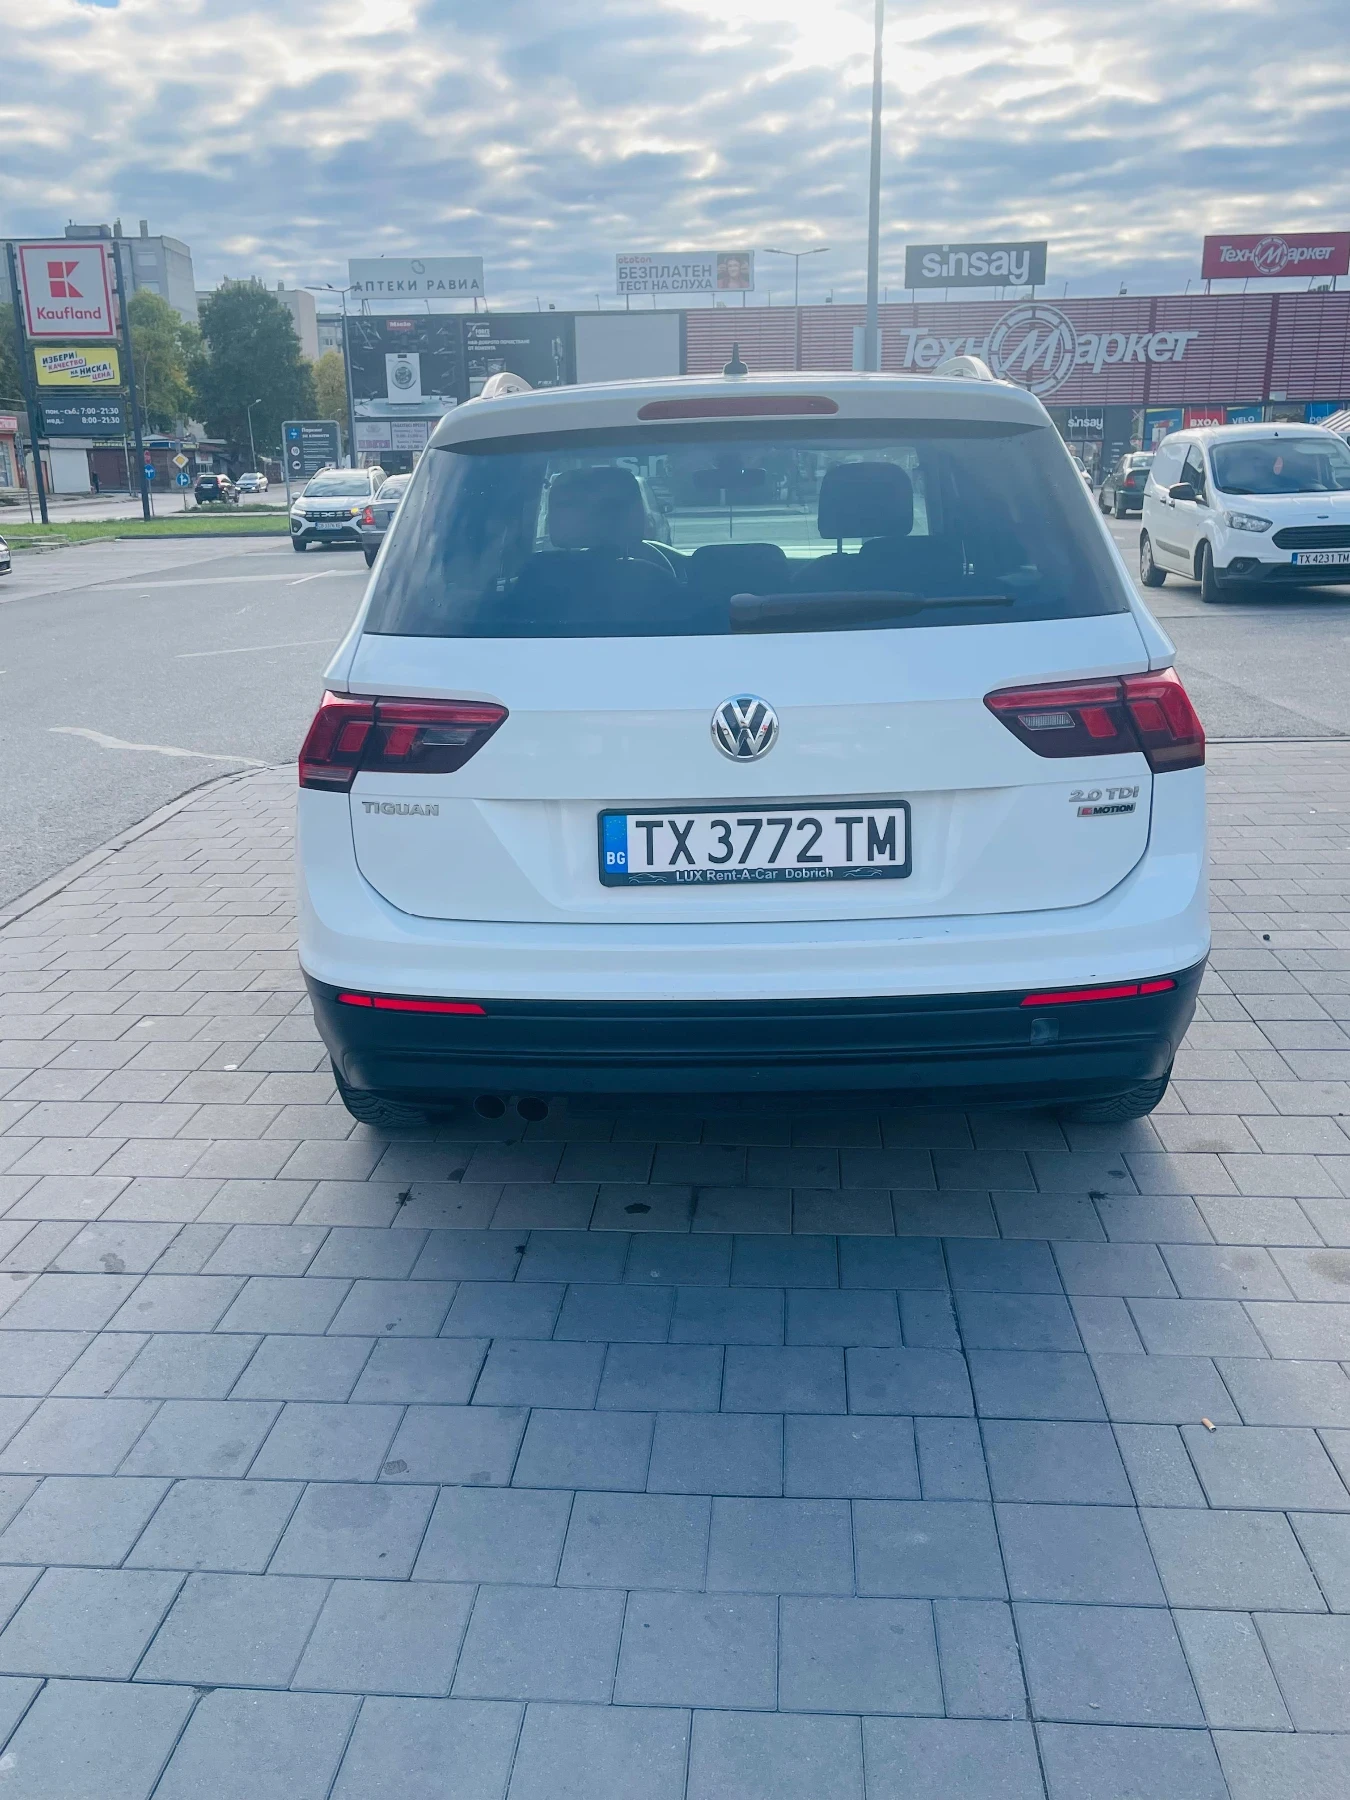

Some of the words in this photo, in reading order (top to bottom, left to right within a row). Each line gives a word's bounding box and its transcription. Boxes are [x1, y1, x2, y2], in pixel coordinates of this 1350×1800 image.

[618, 256, 652, 264] ototon
[922, 245, 1030, 285] sinsay
[619, 265, 712, 280] БЕЗПЛАТЕН
[354, 280, 417, 292] АПТЕКИ
[427, 279, 479, 290] РАВИА
[619, 280, 648, 291] ТЕСТ
[652, 280, 669, 290] НА
[672, 279, 713, 289] СЛУХА
[37, 306, 101, 319] Kaufland
[42, 352, 75, 364] ИЗБЕРИ
[48, 359, 84, 370] КАЧЕСТВО
[80, 364, 108, 375] НИСКА
[92, 371, 111, 380] ЦЕНА
[1068, 416, 1104, 430] sinsay
[1232, 416, 1255, 425] VELO
[1299, 554, 1311, 564] TX
[1312, 554, 1335, 564] 4231
[1338, 553, 1350, 563] TM
[1069, 789, 1102, 802] 2.0
[1106, 786, 1139, 800] TDI
[362, 801, 439, 816] TIGUAN
[636, 819, 696, 866] TX
[708, 817, 823, 864] 3772
[835, 815, 896, 862] TM
[606, 851, 626, 865] BG
[676, 869, 703, 882] LUX
[707, 868, 778, 882] Rent-A-Car
[785, 867, 834, 880] Dobrich
